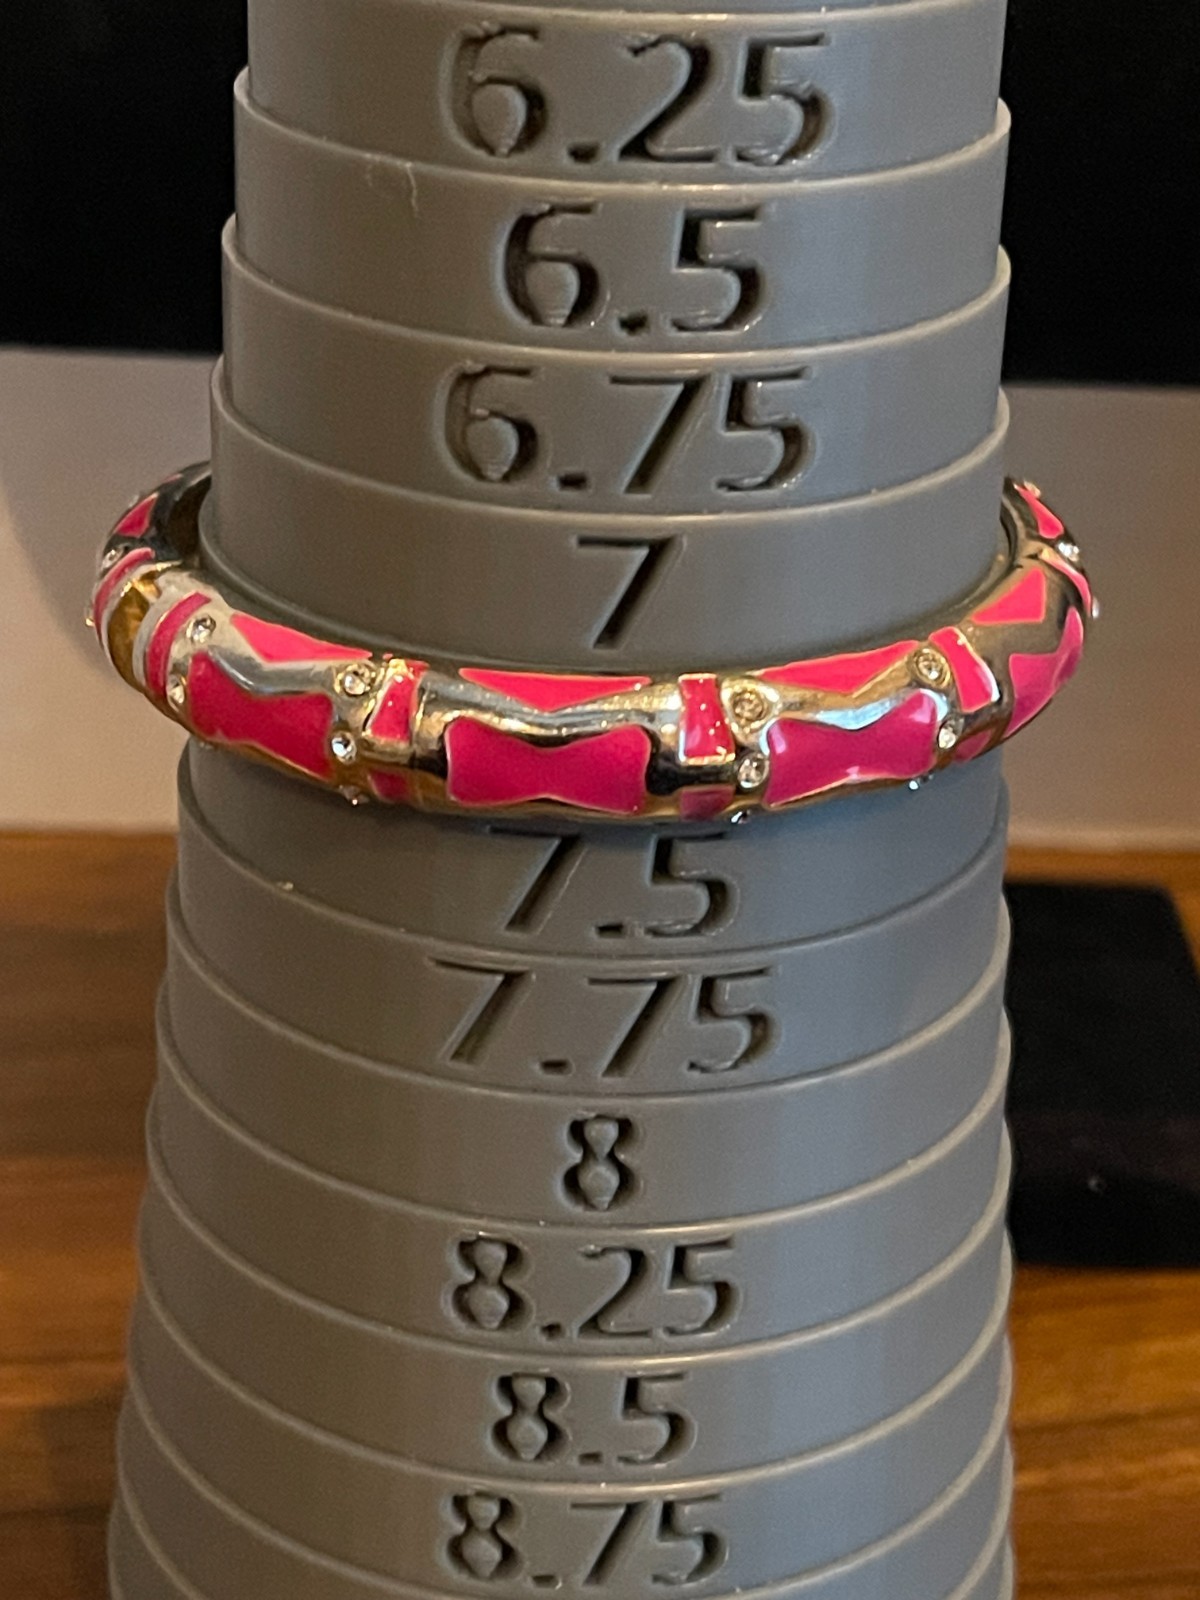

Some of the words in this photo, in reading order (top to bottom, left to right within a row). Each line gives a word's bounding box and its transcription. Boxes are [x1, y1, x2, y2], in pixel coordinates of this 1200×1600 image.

[444, 25, 835, 167] 6.25
[497, 200, 766, 332] 6.5
[437, 362, 815, 495] 6.75
[574, 535, 685, 650] 7
[487, 824, 738, 936] 7.5
[430, 958, 779, 1078] 7.75
[559, 1112, 642, 1212] 8
[447, 1233, 743, 1338] 8.25
[489, 1370, 697, 1467] 8.5
[443, 1491, 728, 1586] 8.75
